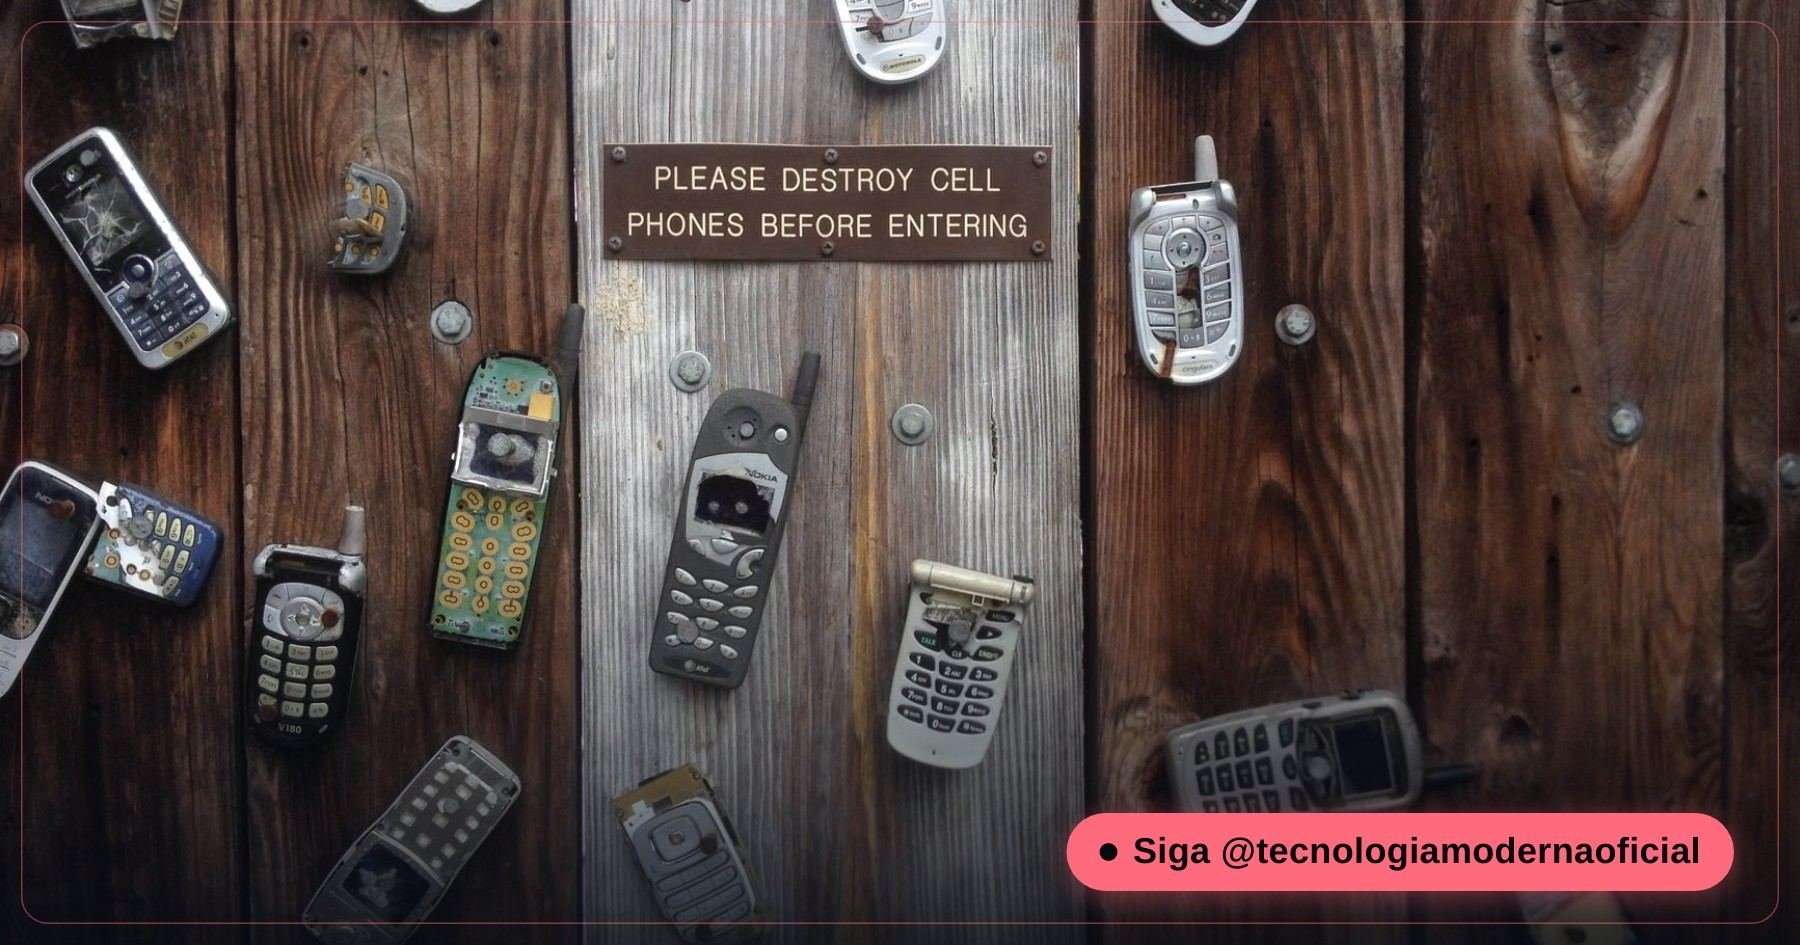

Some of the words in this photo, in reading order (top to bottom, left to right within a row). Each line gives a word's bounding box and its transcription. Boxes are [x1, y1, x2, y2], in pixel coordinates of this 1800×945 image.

[655, 165, 766, 191] PLEASE
[782, 167, 914, 193] DESTROY
[930, 167, 1001, 192] CELL
[628, 212, 744, 238] PHONES
[761, 212, 873, 238] BEFORE
[888, 213, 1027, 238] ENTERING
[744, 466, 778, 483] NOKIA
[920, 636, 937, 646] TALK
[278, 722, 302, 734] V180
